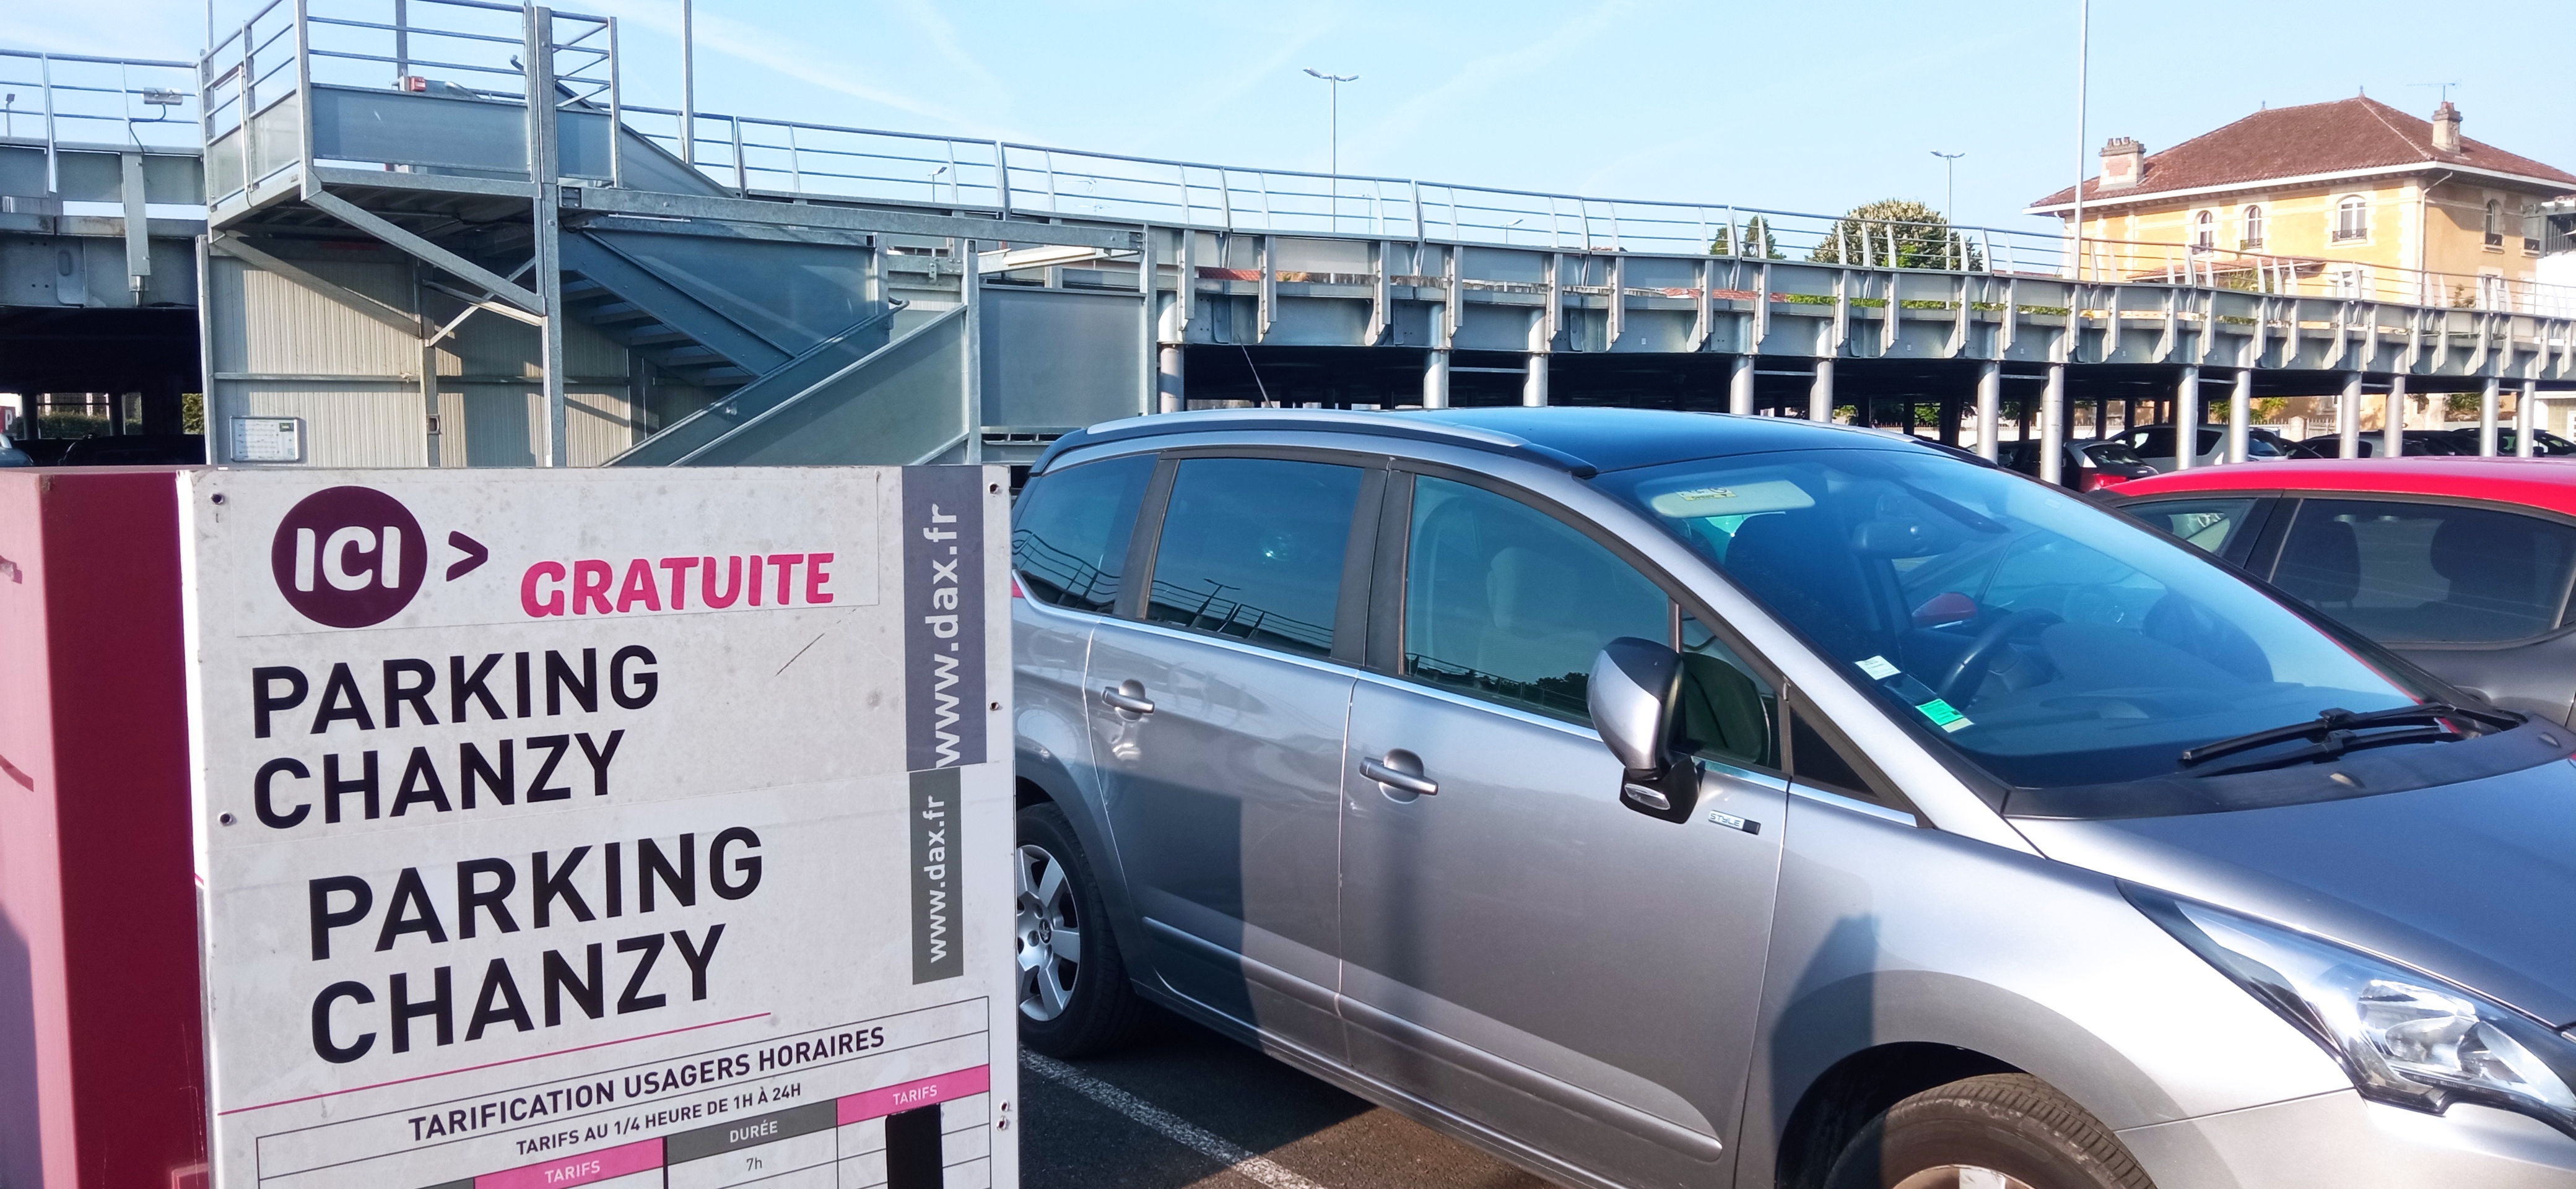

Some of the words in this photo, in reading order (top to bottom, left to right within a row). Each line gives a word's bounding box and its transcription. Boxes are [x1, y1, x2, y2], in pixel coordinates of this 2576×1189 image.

[295, 526, 401, 592] ICI
[521, 553, 834, 618] GRATUITE
[923, 503, 960, 769] www.dax.fr
[252, 645, 659, 739] PARKING
[254, 729, 625, 829] CHANZY
[1710, 813, 1741, 827] STYLE
[308, 827, 763, 962] PARKING
[922, 795, 947, 964] www.dax.fr
[311, 923, 726, 1064] CHANZY
[409, 1080, 614, 1141] TARIFICATION
[624, 1054, 750, 1098] USAGERS
[759, 1026, 885, 1071] HORAIRES
[516, 1130, 580, 1156] TARIFS
[584, 1123, 608, 1143] AU
[614, 1117, 640, 1136] 1/4
[645, 1104, 702, 1131] HEURE
[707, 1098, 729, 1115] DE
[733, 1092, 754, 1110] 1H
[757, 1086, 768, 1105] À
[772, 1082, 801, 1100] 24H
[892, 1084, 938, 1106] TARIFS
[729, 1120, 778, 1144] DURÉE
[746, 1156, 763, 1172] 7h
[545, 1160, 601, 1184] TARIFS
